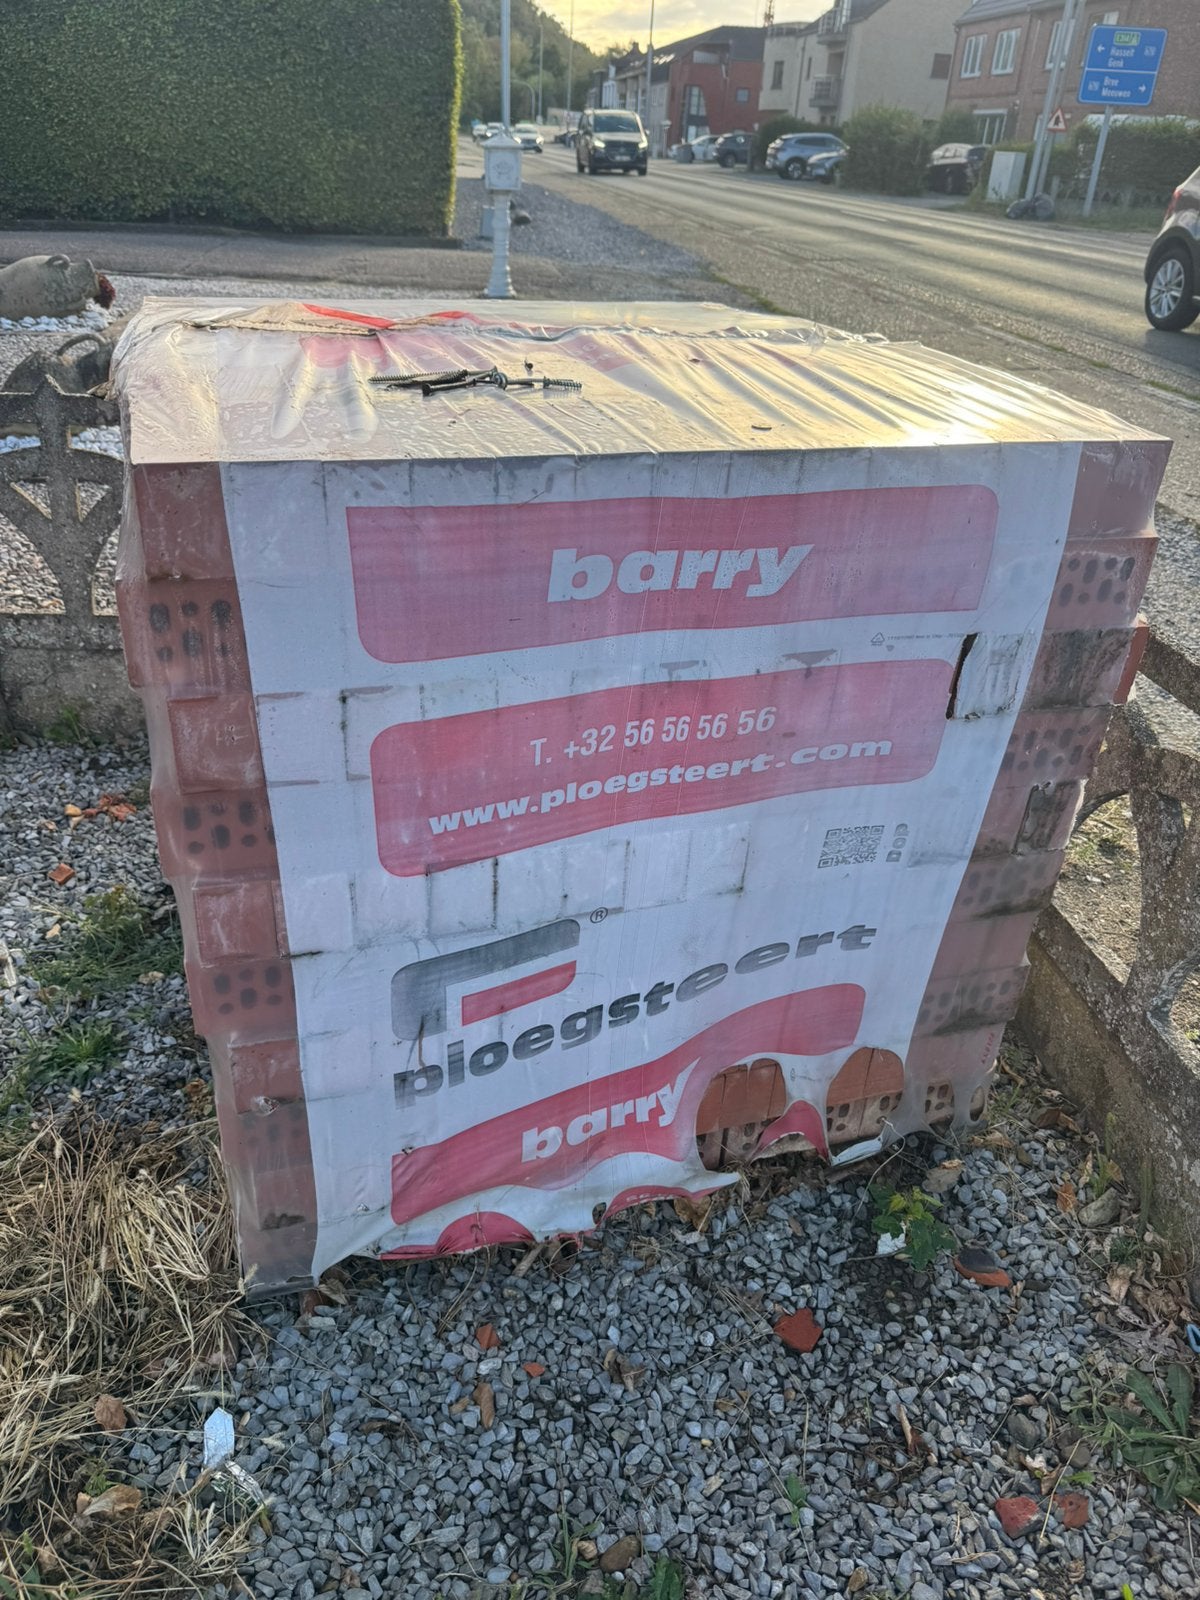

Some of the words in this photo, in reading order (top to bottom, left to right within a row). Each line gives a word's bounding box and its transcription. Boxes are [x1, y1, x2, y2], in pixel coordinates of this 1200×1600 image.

[547, 544, 815, 602] barry
[530, 738, 552, 767] T.
[564, 724, 616, 759] +32
[624, 718, 655, 748] 56
[661, 715, 691, 743] 56
[696, 713, 728, 740] 56
[737, 706, 777, 735] 56
[429, 739, 893, 835] www.ploegsteert.com
[393, 924, 877, 1110] ploegsteert
[521, 1056, 701, 1163] barry
